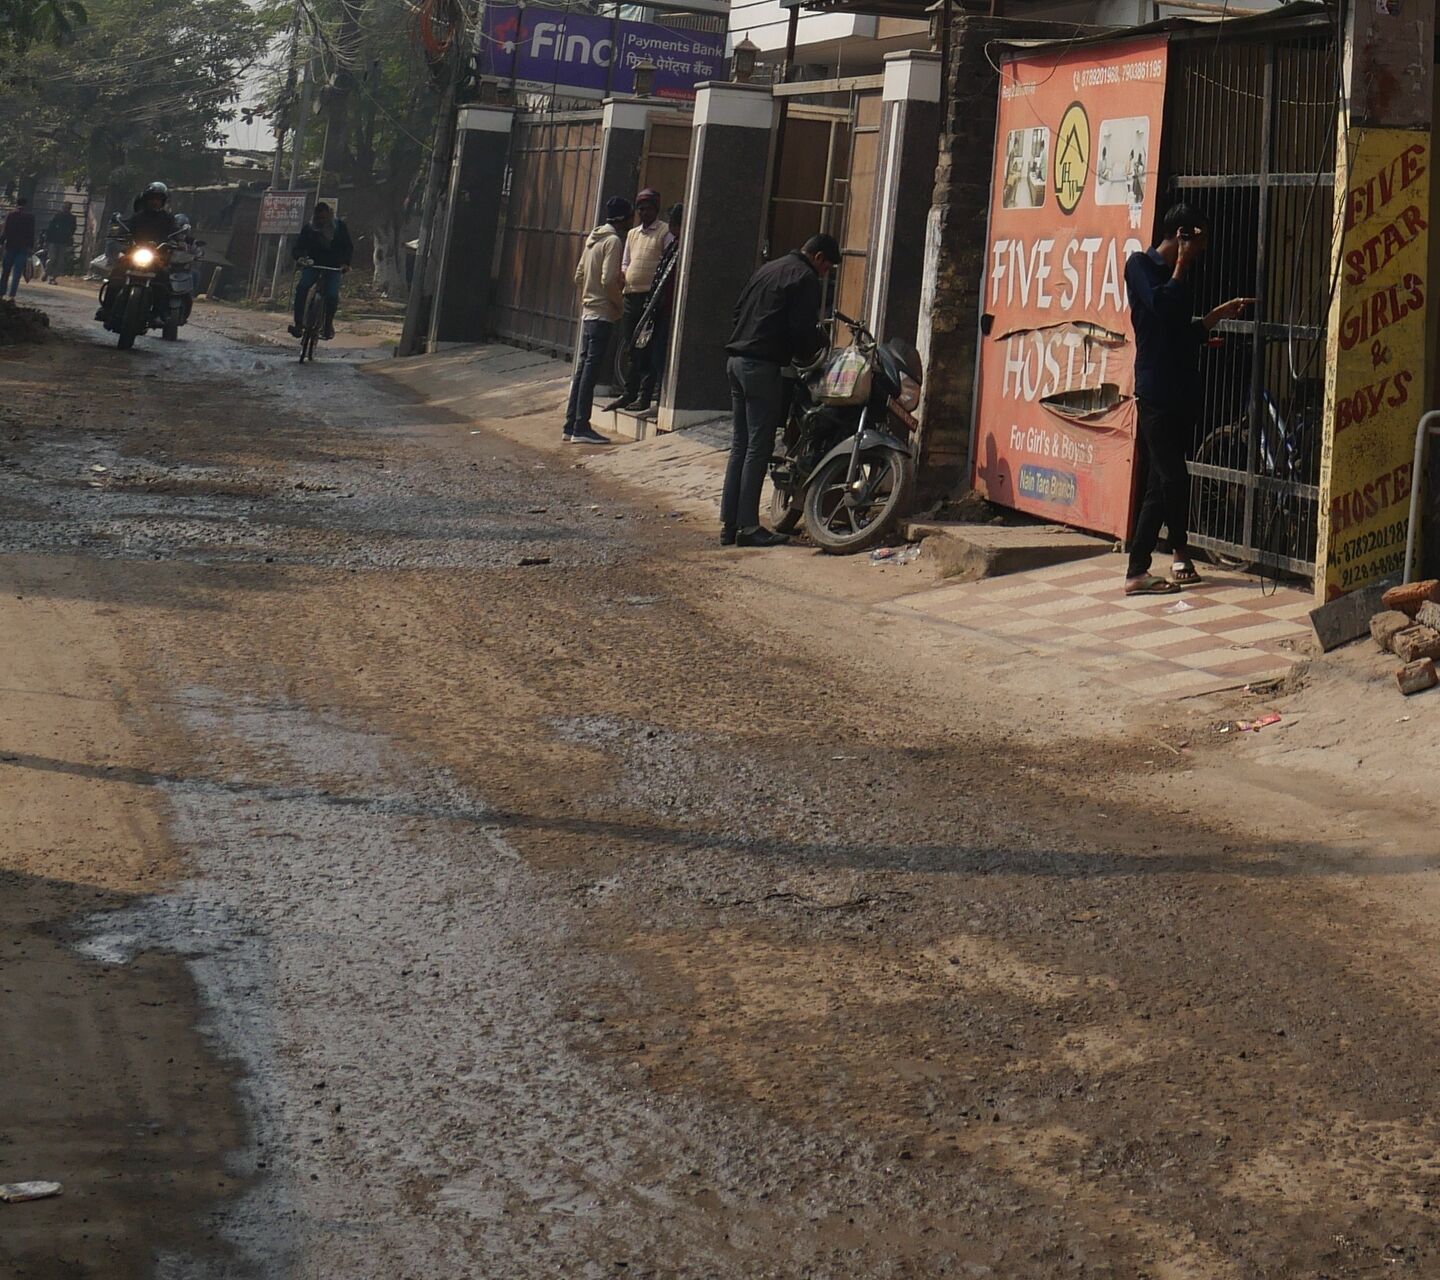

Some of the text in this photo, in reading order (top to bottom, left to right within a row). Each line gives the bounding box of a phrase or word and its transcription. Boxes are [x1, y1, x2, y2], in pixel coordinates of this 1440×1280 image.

[628, 34, 689, 53] Payments
[692, 43, 722, 57] Bank
[1345, 143, 1425, 233] FIVE
[991, 238, 1054, 309] FIVE
[1345, 204, 1428, 286] STAR
[1338, 272, 1424, 351] GIRLS
[1335, 368, 1412, 434] BOYS
[1010, 425, 1024, 450] For
[1026, 427, 1050, 458] Girl's
[1052, 440, 1059, 458] &
[1019, 469, 1075, 500] Nain Tara Branch
